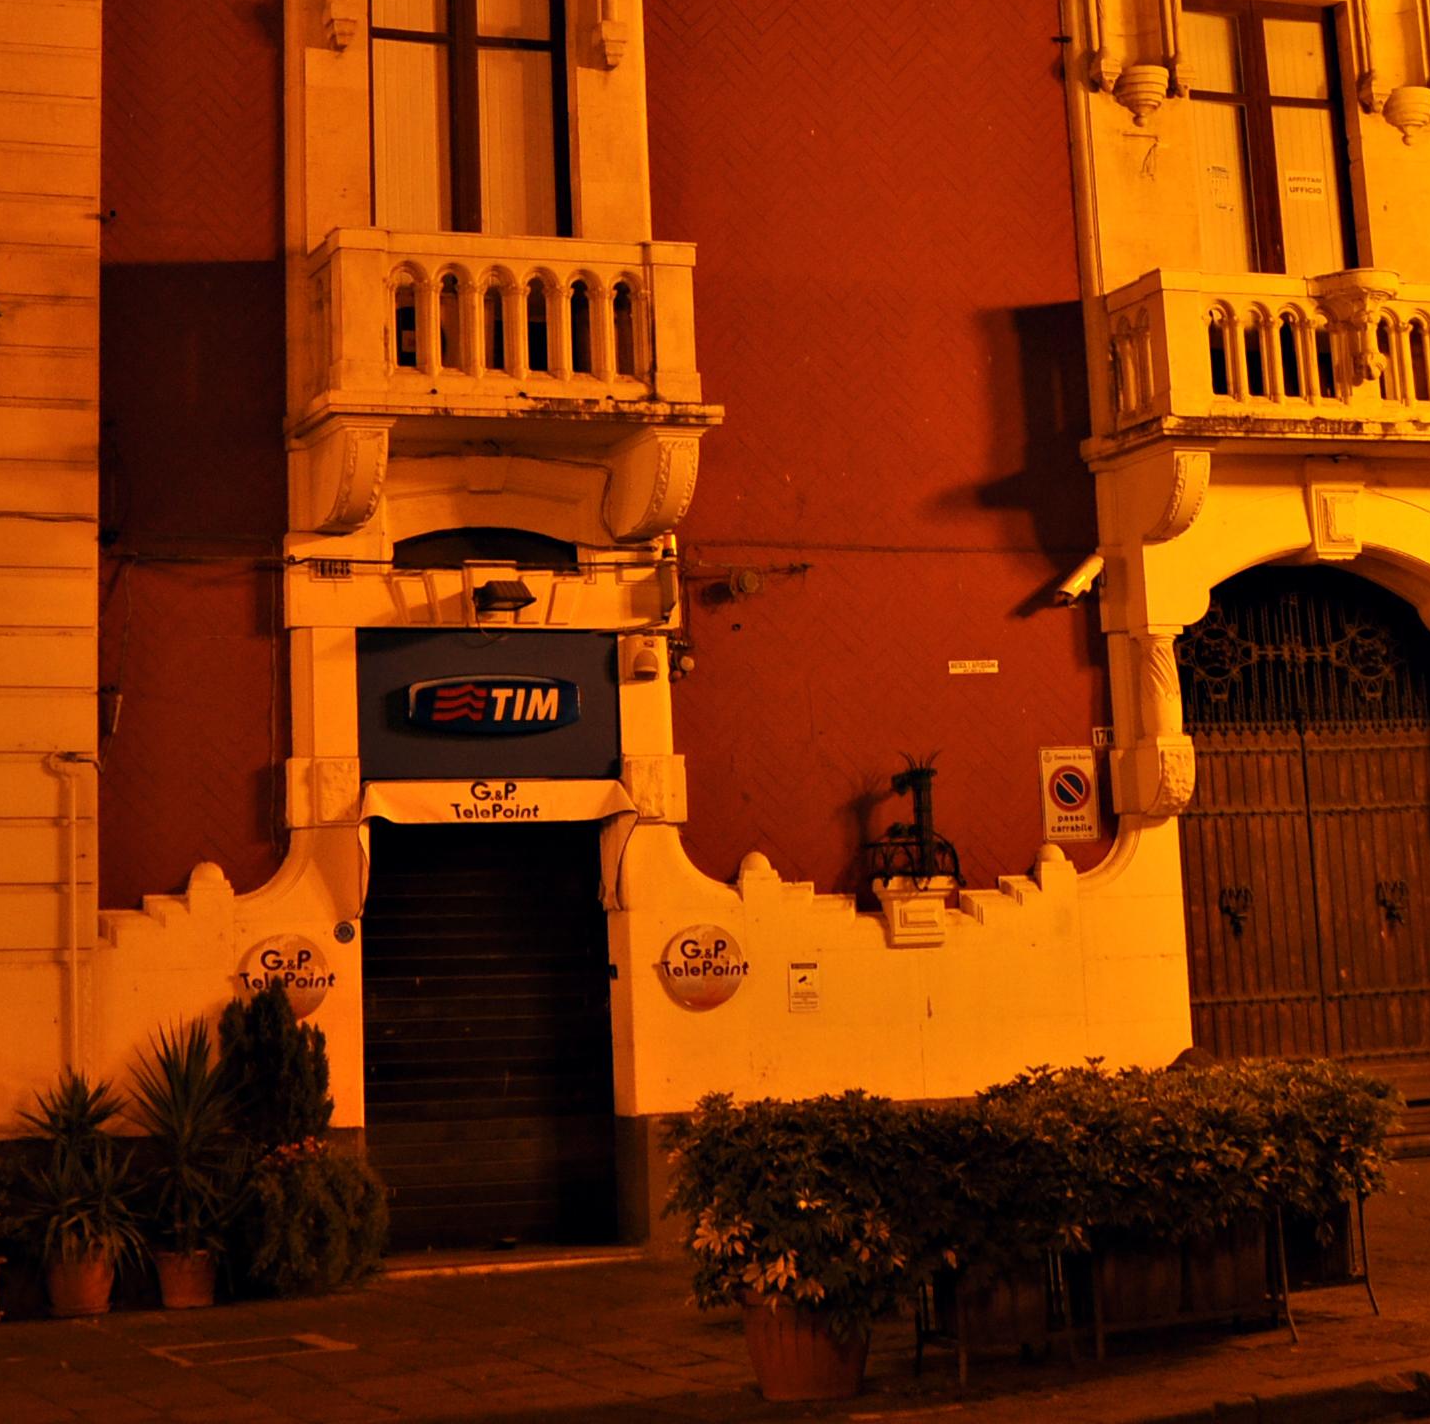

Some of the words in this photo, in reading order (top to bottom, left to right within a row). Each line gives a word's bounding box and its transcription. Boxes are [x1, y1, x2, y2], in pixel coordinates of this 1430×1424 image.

[491, 687, 559, 721] TIM
[451, 803, 540, 819] TelePoint
[1058, 815, 1085, 823] passo
[1051, 823, 1093, 833] carrabile
[661, 961, 749, 977] TelePoint
[239, 972, 336, 989] TelPoint
